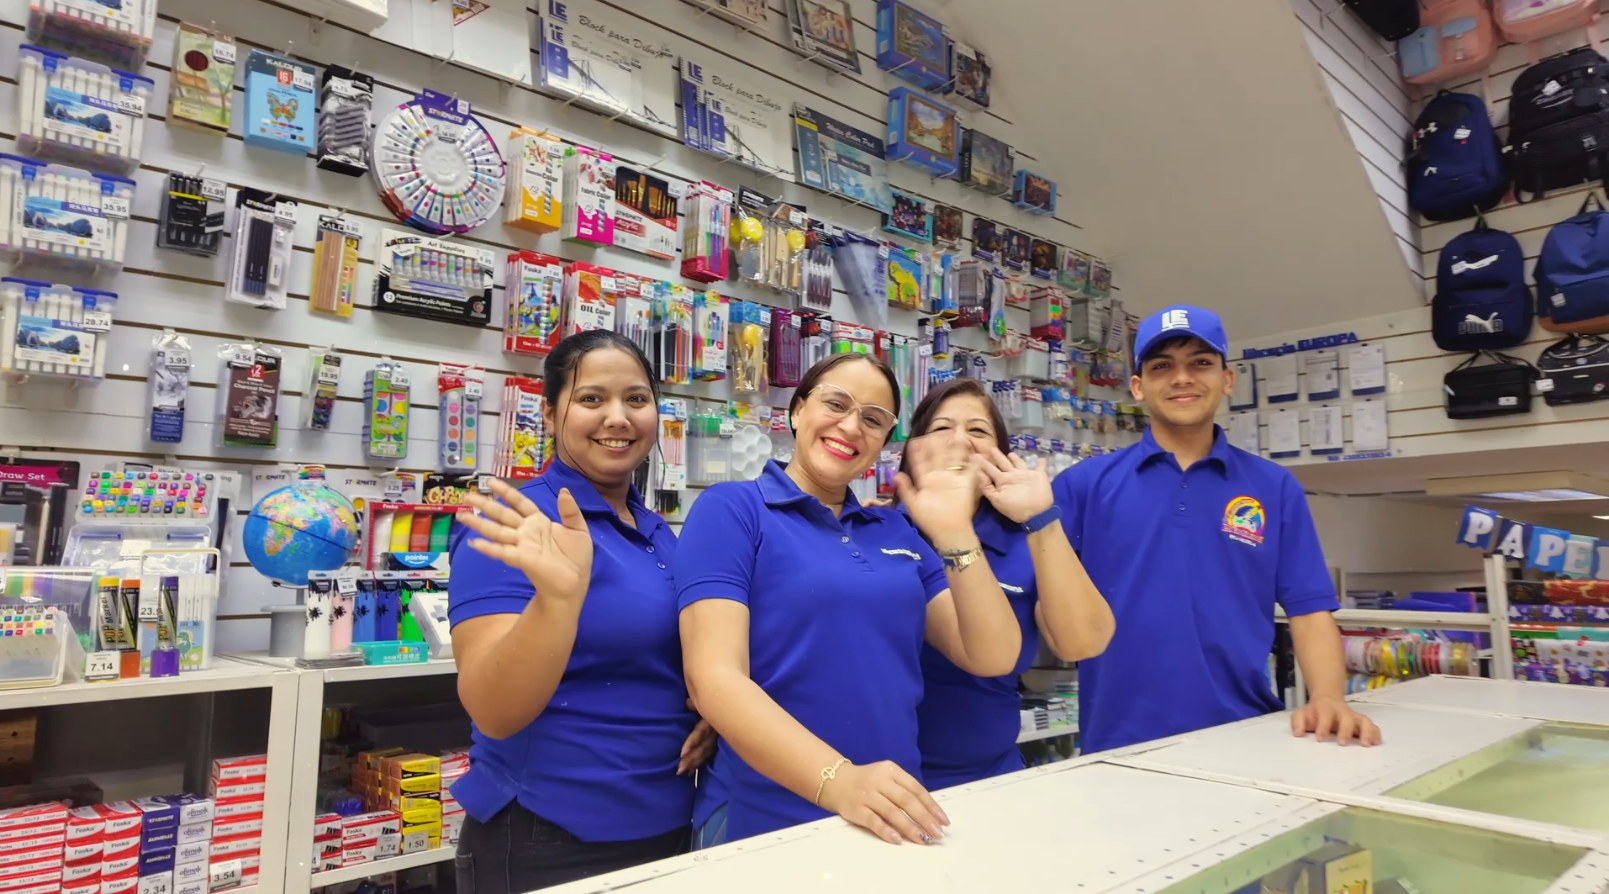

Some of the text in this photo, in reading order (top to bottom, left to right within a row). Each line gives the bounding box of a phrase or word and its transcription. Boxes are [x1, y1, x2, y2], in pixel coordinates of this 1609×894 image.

[549, 1, 567, 21] LE
[579, 15, 605, 34] Block
[608, 30, 630, 45] para
[552, 29, 563, 43] LE
[279, 71, 289, 82] 16
[688, 62, 702, 80] LE
[711, 75, 782, 112] Block para Dibujo
[119, 99, 143, 112] 35.94
[203, 186, 225, 197] 12.95
[103, 202, 127, 214] 35.95
[524, 264, 542, 274] Foska
[580, 304, 612, 317] OIL Color
[85, 317, 109, 328] 28.74
[1162, 309, 1189, 330] LE
[168, 355, 188, 366] 3.95
[234, 352, 253, 362] 9.54
[394, 376, 408, 385] 2.40
[521, 394, 538, 402] Foska
[0, 470, 45, 482] Draw Set
[345, 478, 377, 487] STARMATE
[140, 607, 161, 616] 23.9
[90, 661, 114, 673] 7.14
[113, 819, 132, 828] Foska
[75, 825, 95, 834] Foska
[111, 840, 130, 849] Foska
[379, 844, 396, 853] 1.74
[408, 839, 425, 849] 1.50
[74, 846, 94, 855] Foska
[109, 860, 128, 870] Foska
[72, 867, 92, 876] Foska
[214, 870, 235, 882] 3.54
[109, 880, 128, 890] Foska
[143, 883, 167, 894] 2.34
